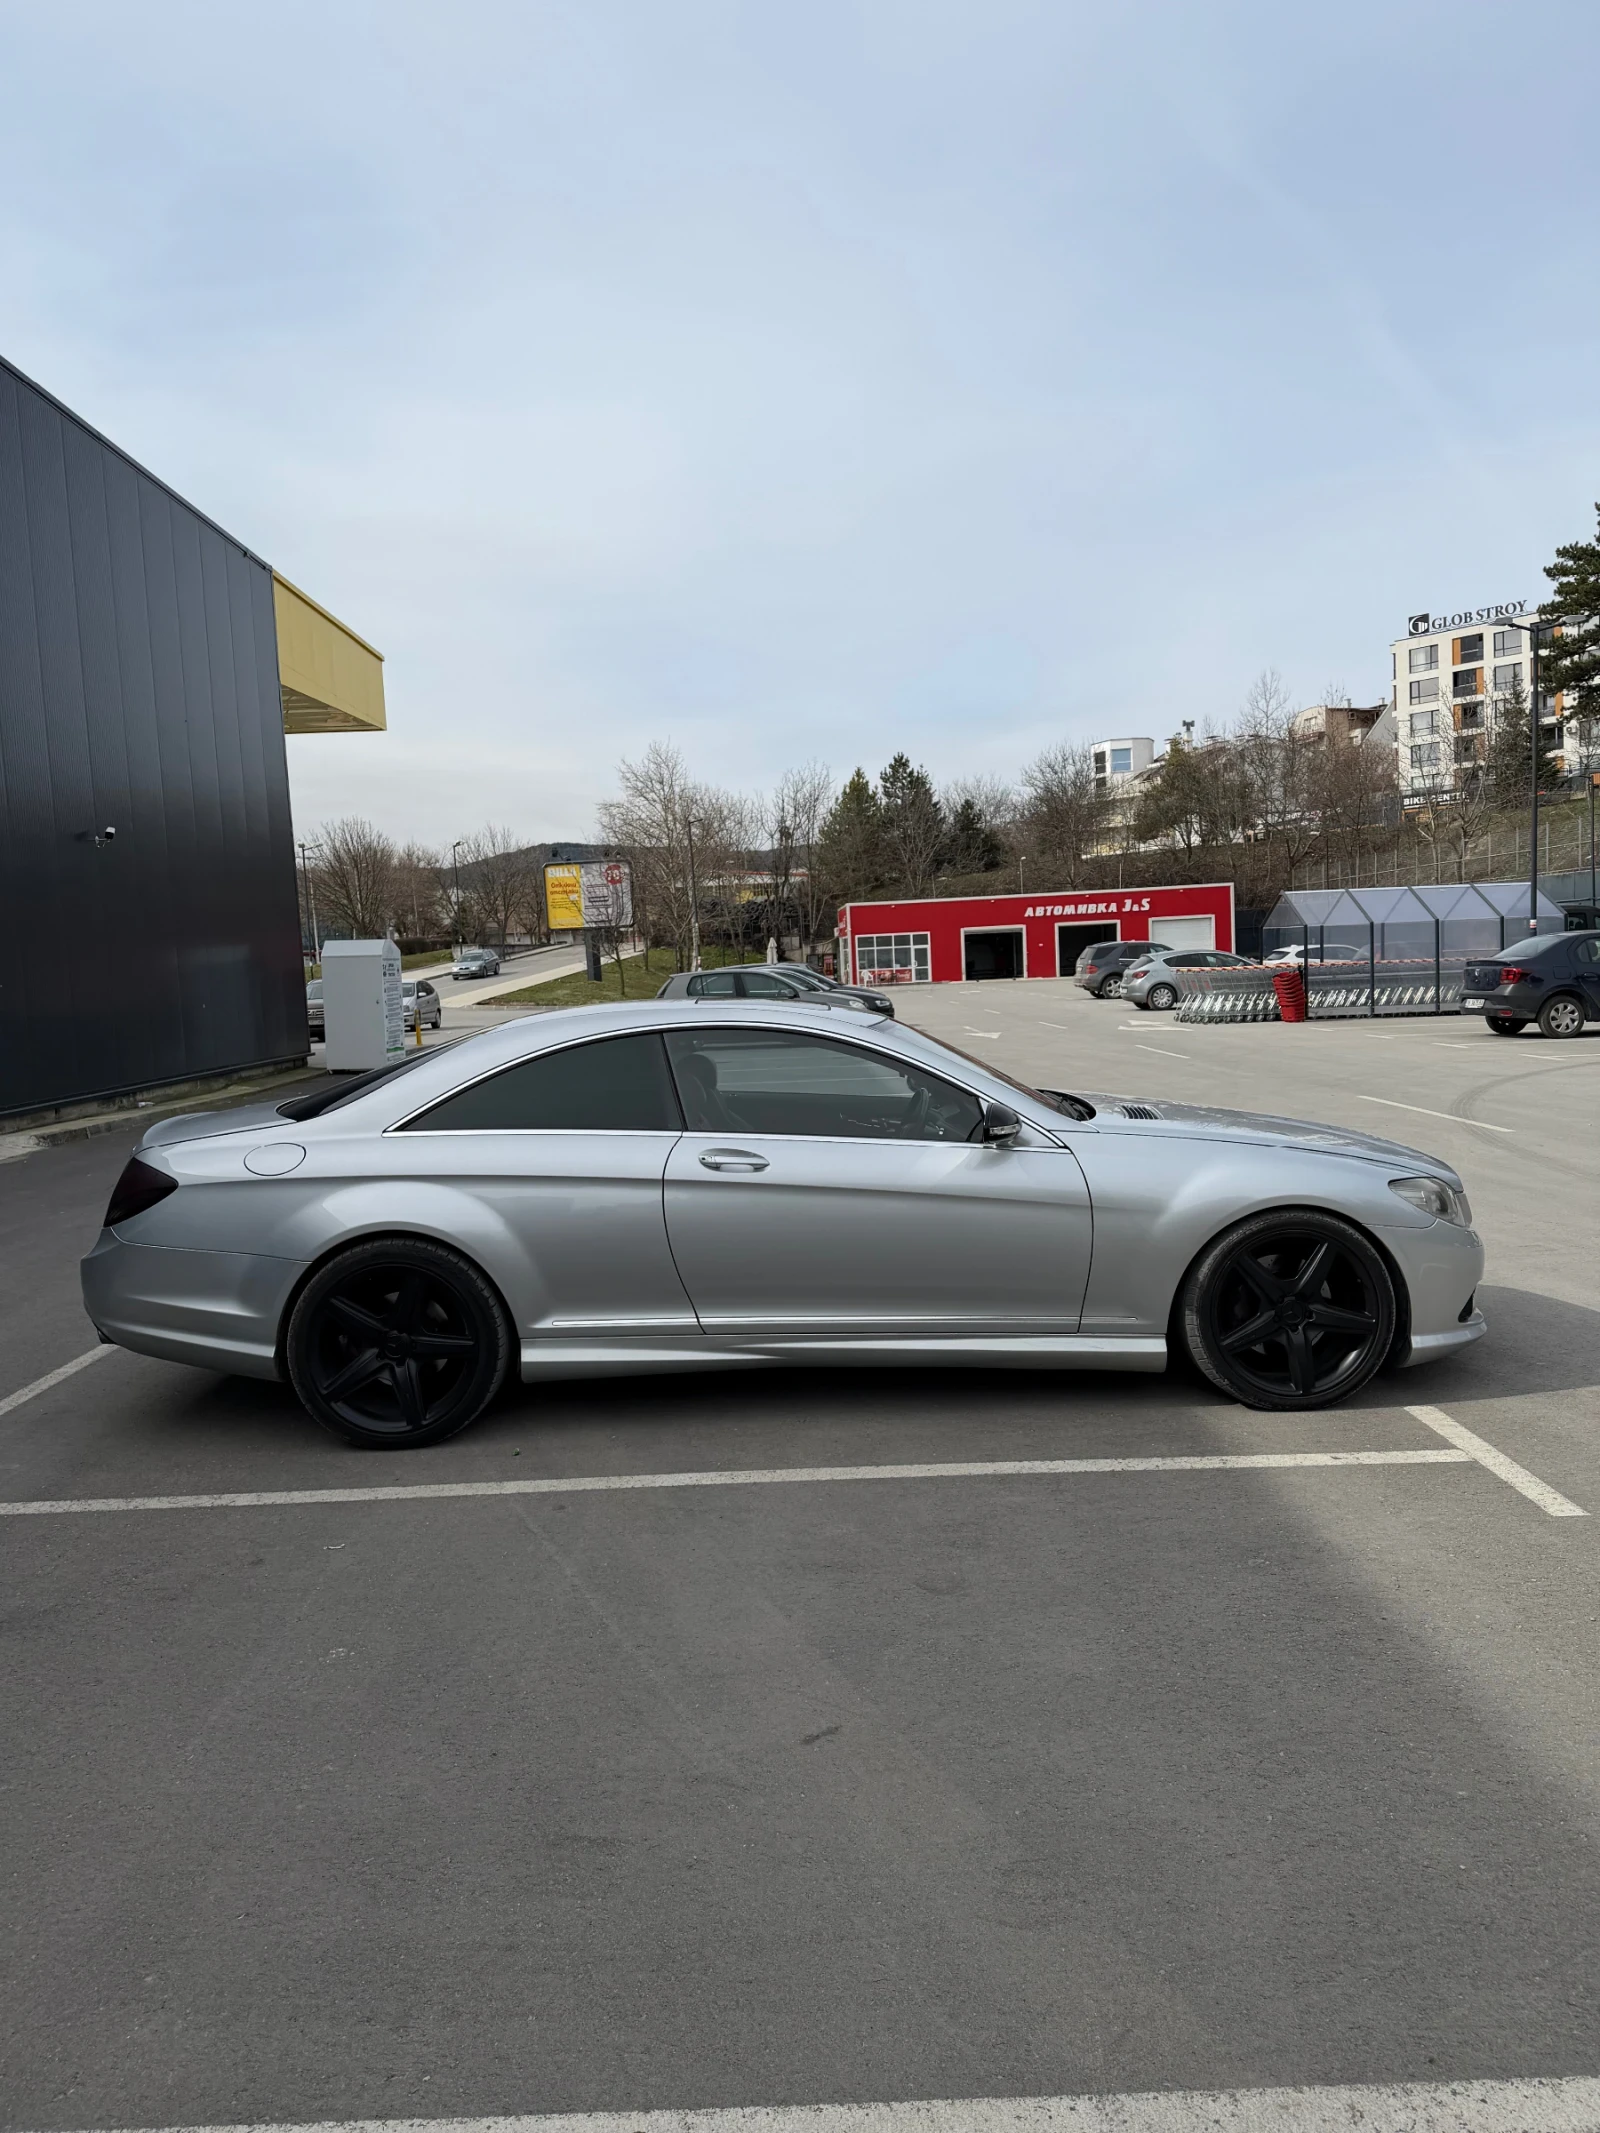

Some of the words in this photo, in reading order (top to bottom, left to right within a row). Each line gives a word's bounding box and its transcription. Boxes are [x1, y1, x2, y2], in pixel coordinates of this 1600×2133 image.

[1431, 611, 1473, 630] GLOB
[1476, 600, 1527, 620] STROY
[1403, 796, 1427, 805] BIKE
[548, 867, 577, 877] BILLA
[1024, 902, 1118, 917] АВТОМИВКА
[1122, 898, 1151, 912] J&S
